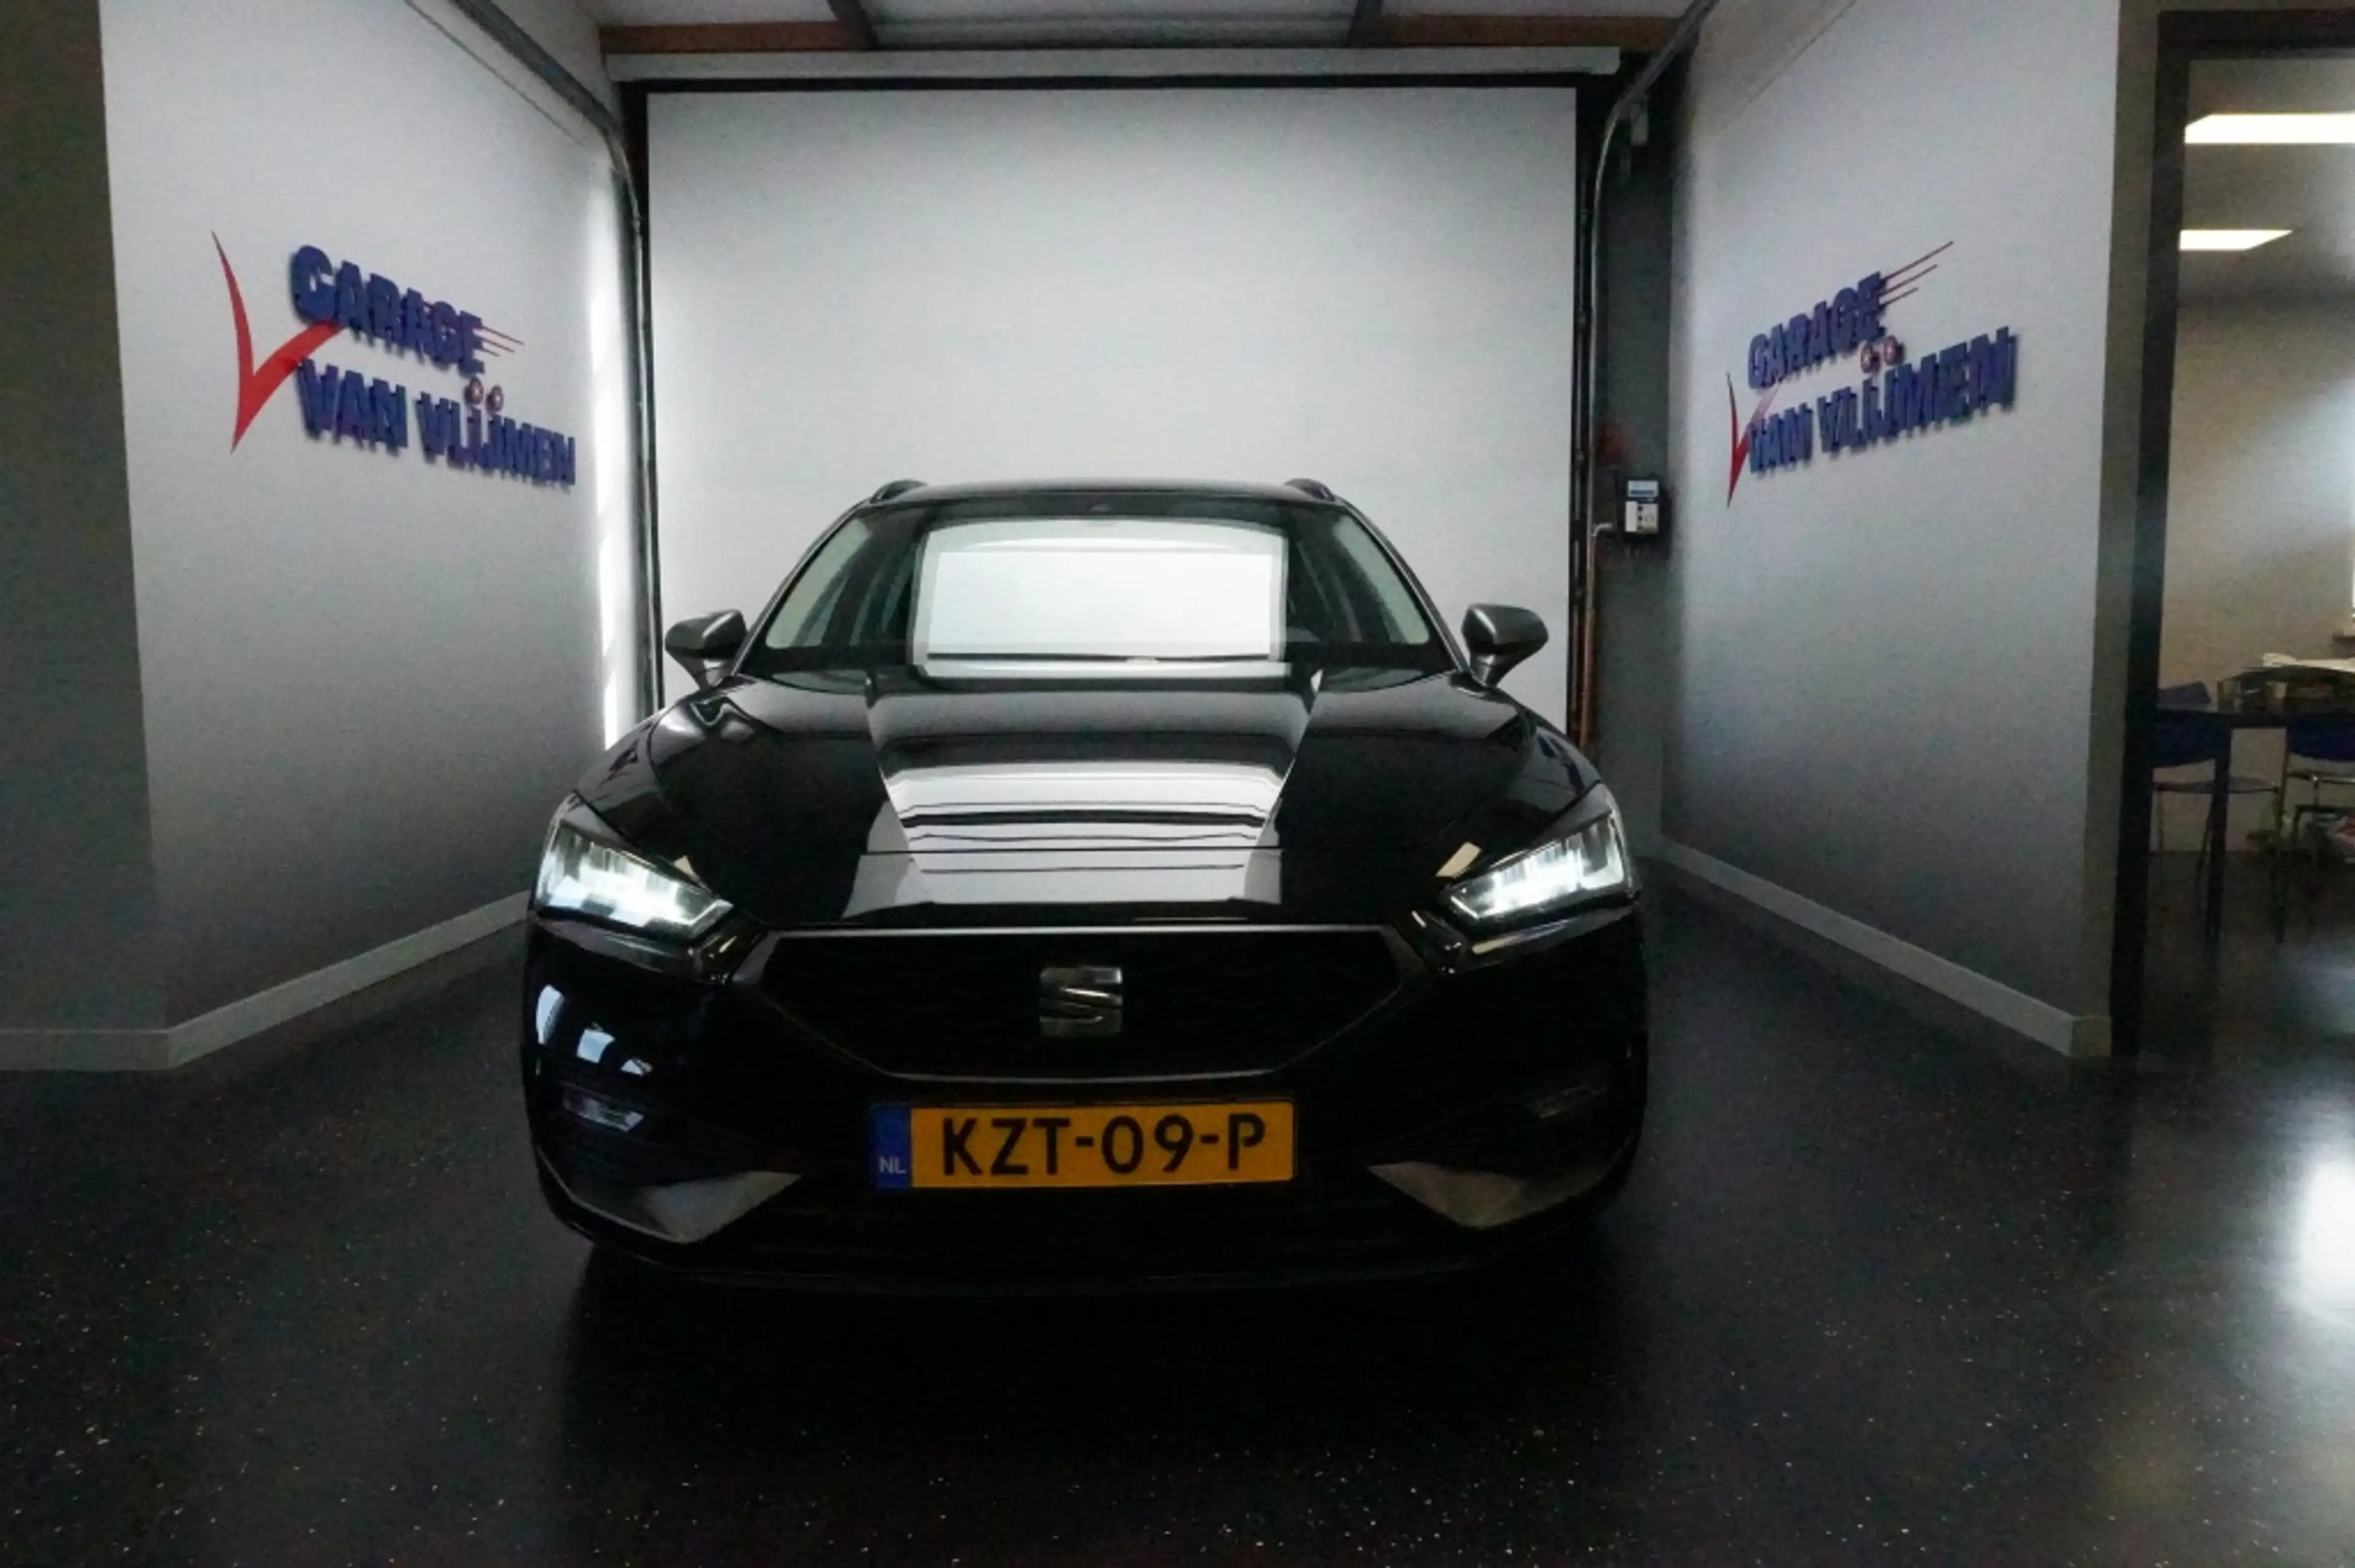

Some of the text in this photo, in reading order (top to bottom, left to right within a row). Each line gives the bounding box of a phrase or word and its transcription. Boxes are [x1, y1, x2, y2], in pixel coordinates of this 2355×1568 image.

[291, 245, 484, 373] GARAGE
[1748, 271, 1884, 389] GARAGE
[298, 356, 408, 453] VAN
[1748, 403, 1813, 475] VAN
[879, 1157, 906, 1173] NL
[943, 1112, 1265, 1176] KZT-09-P
